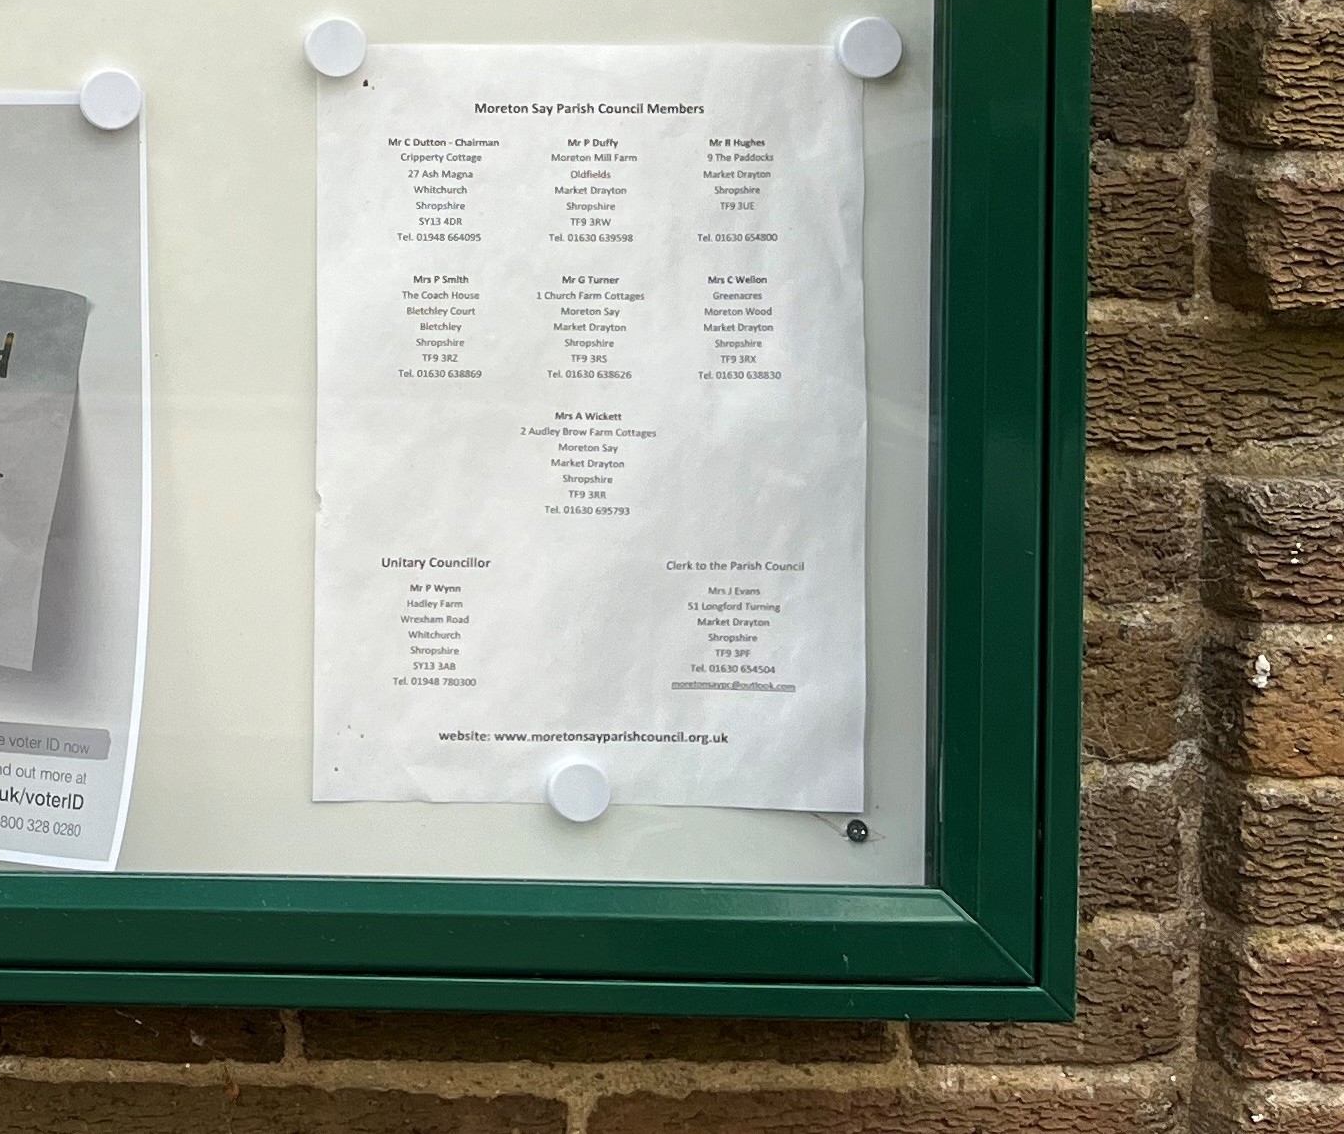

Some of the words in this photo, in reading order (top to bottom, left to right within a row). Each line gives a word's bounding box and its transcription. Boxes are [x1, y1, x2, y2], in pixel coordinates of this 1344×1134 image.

[475, 103, 528, 114] Moreton
[532, 103, 553, 116] Say
[557, 103, 595, 114] Parish
[598, 103, 643, 114] Council
[647, 103, 704, 114] Members
[381, 557, 426, 570] Unitary
[429, 557, 491, 568] Councillor
[666, 560, 693, 571] Clerk
[695, 562, 707, 571] to
[709, 561, 728, 570] the
[730, 561, 762, 571] Parish
[764, 561, 805, 571] Council
[8, 736, 42, 750] voter
[46, 737, 61, 752] ID
[63, 742, 90, 754] now
[438, 730, 490, 742] website:
[494, 731, 729, 745] www.moretonsayparishcouncil.org.uk
[15, 766, 36, 779] out
[40, 770, 72, 783] more
[75, 772, 87, 785] at
[26, 818, 50, 834] 328
[53, 821, 81, 837] 0280
